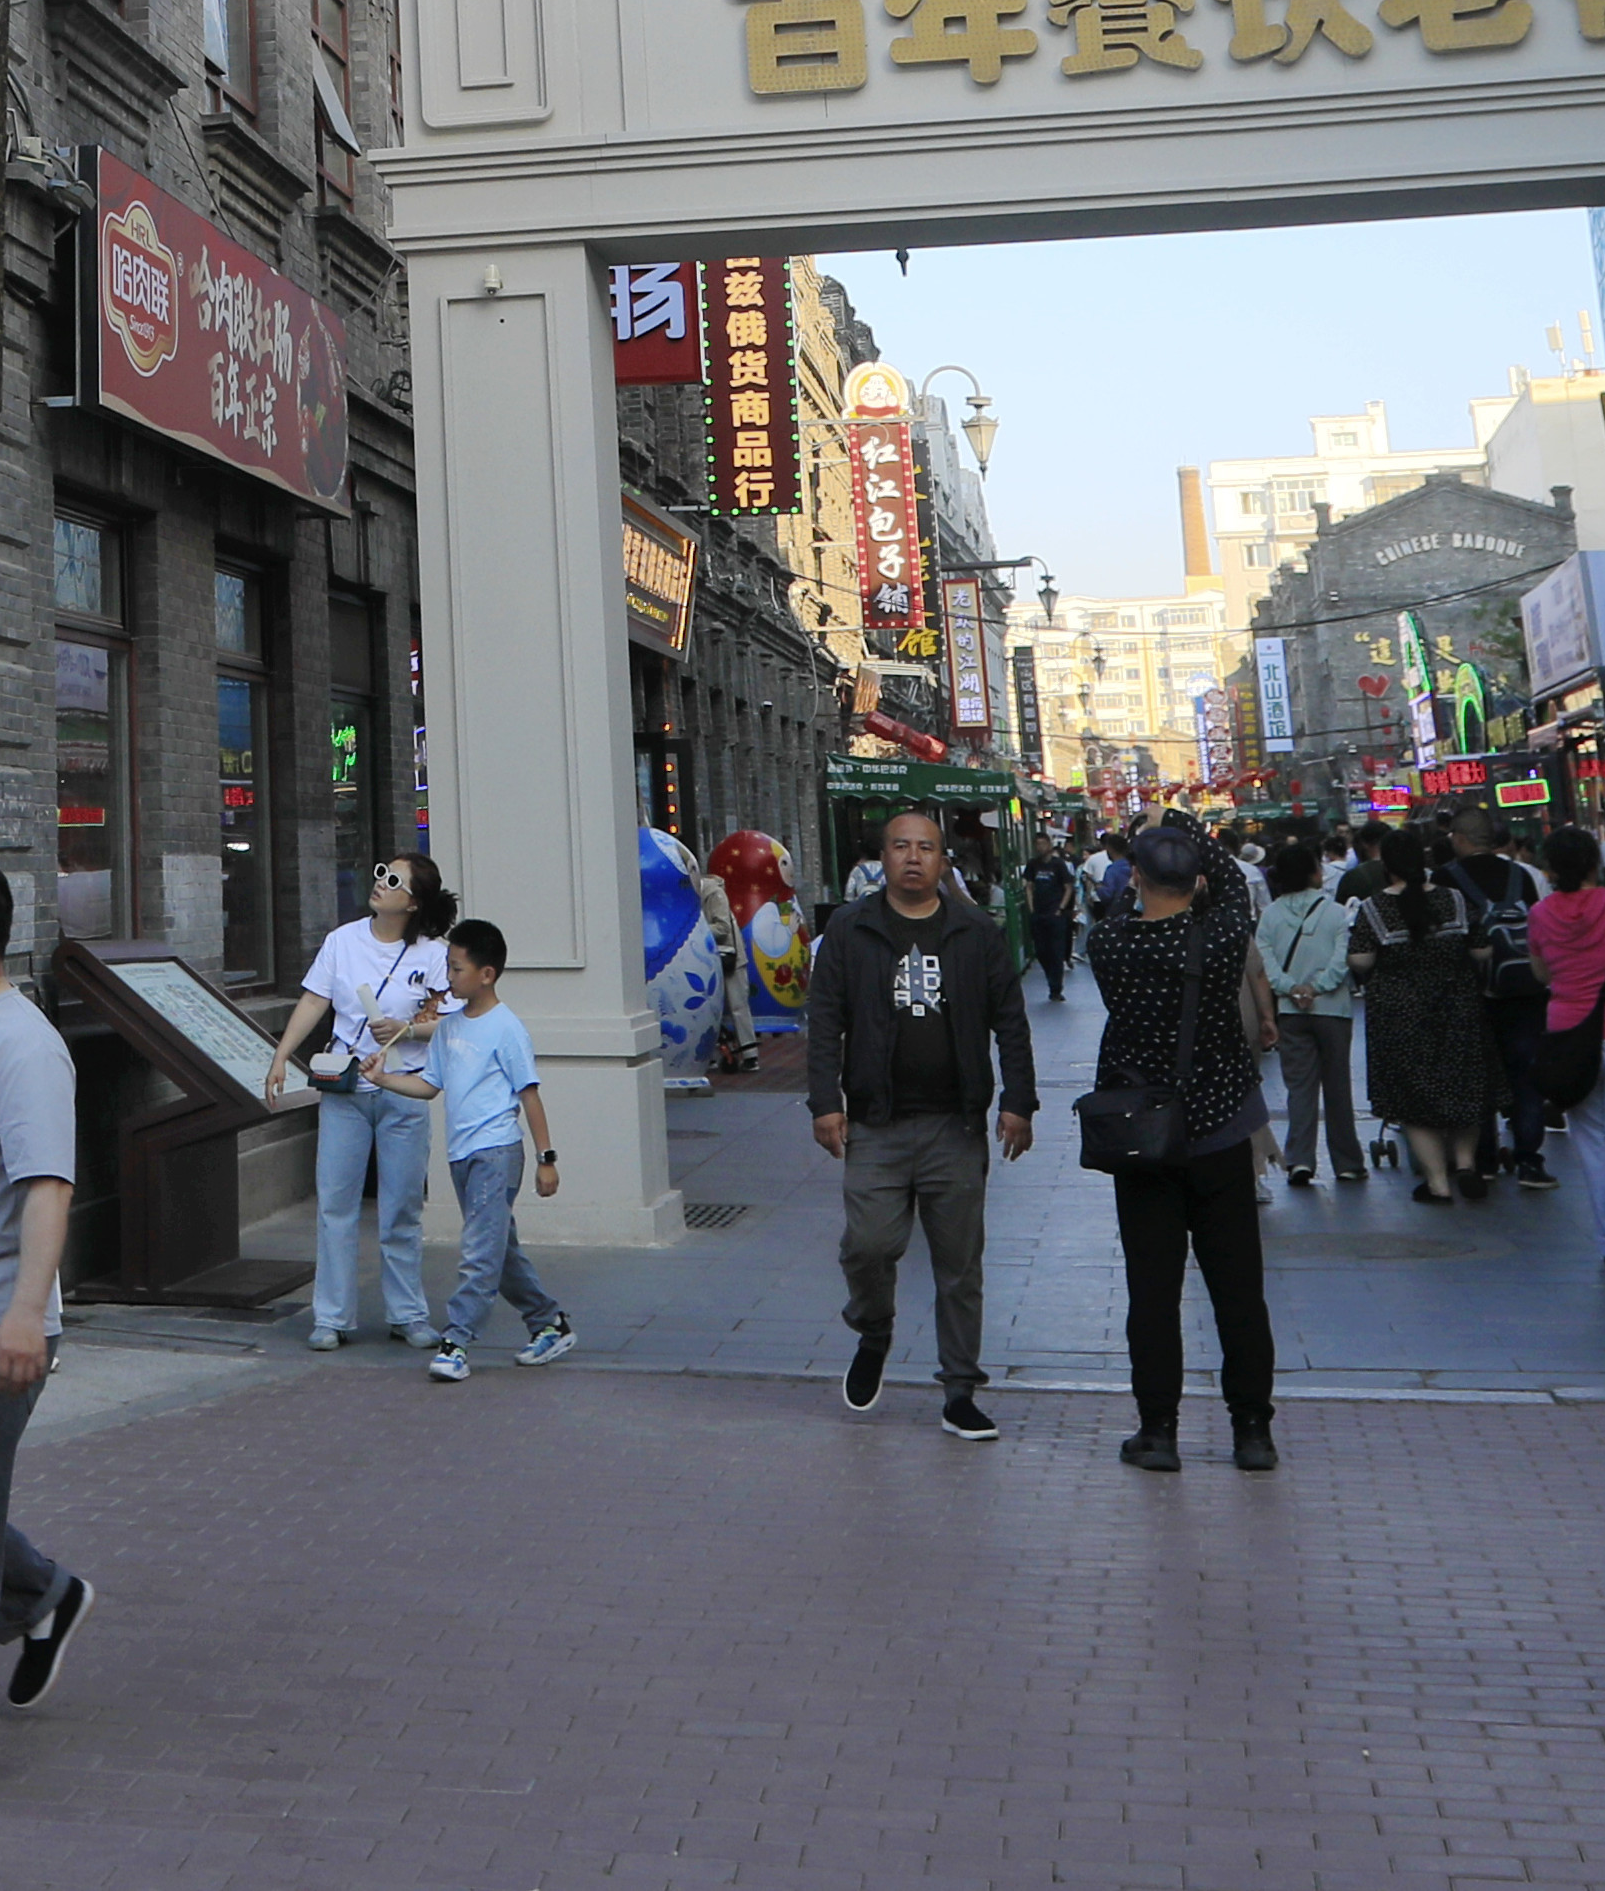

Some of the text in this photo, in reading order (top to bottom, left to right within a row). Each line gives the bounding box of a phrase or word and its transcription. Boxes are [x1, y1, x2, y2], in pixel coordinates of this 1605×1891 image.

[113, 243, 170, 325] 哈肉联
[190, 244, 293, 385] 哈肉联红肠
[1375, 532, 1526, 566] CHINESE BAROQUE
